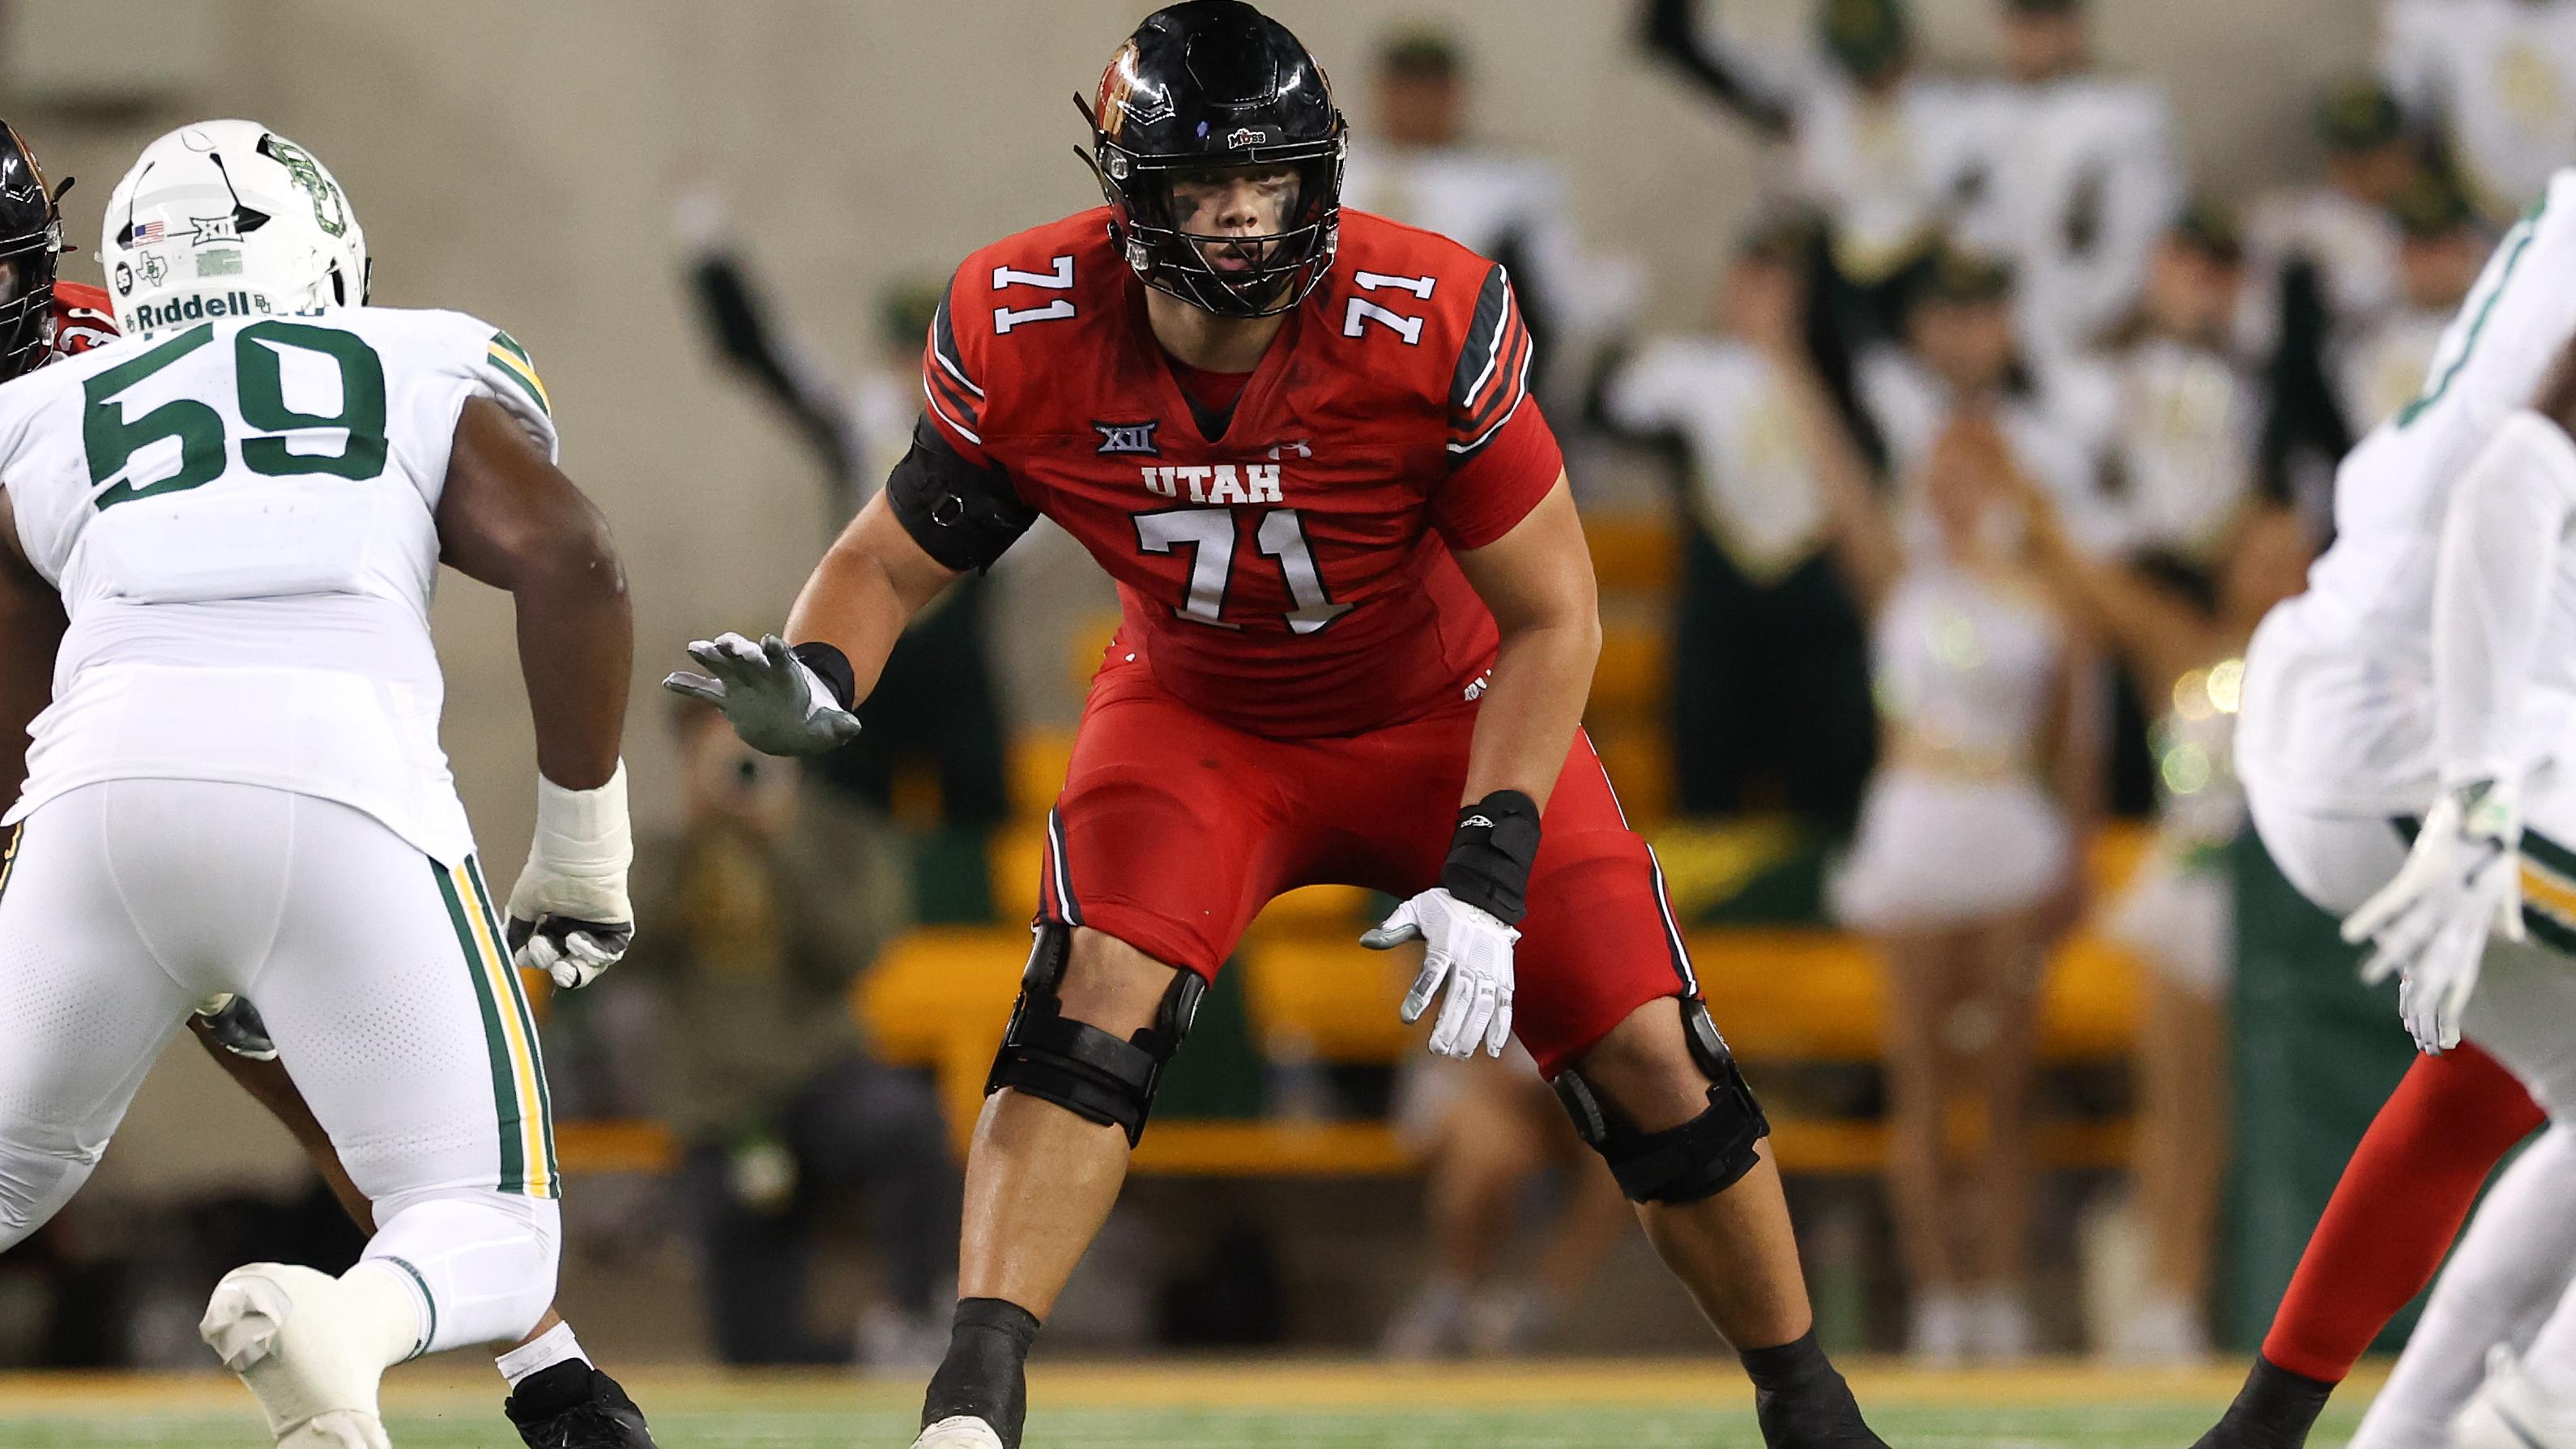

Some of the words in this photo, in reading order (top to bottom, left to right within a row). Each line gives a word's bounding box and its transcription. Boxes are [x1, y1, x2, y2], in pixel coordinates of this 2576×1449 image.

[136, 292, 249, 330] Riddell
[992, 254, 1077, 335] 71
[1342, 270, 1436, 346] 71
[83, 322, 389, 512] 59
[1094, 421, 1158, 455] XII
[1141, 464, 1284, 504] UTAH
[1132, 507, 1355, 635] 71
